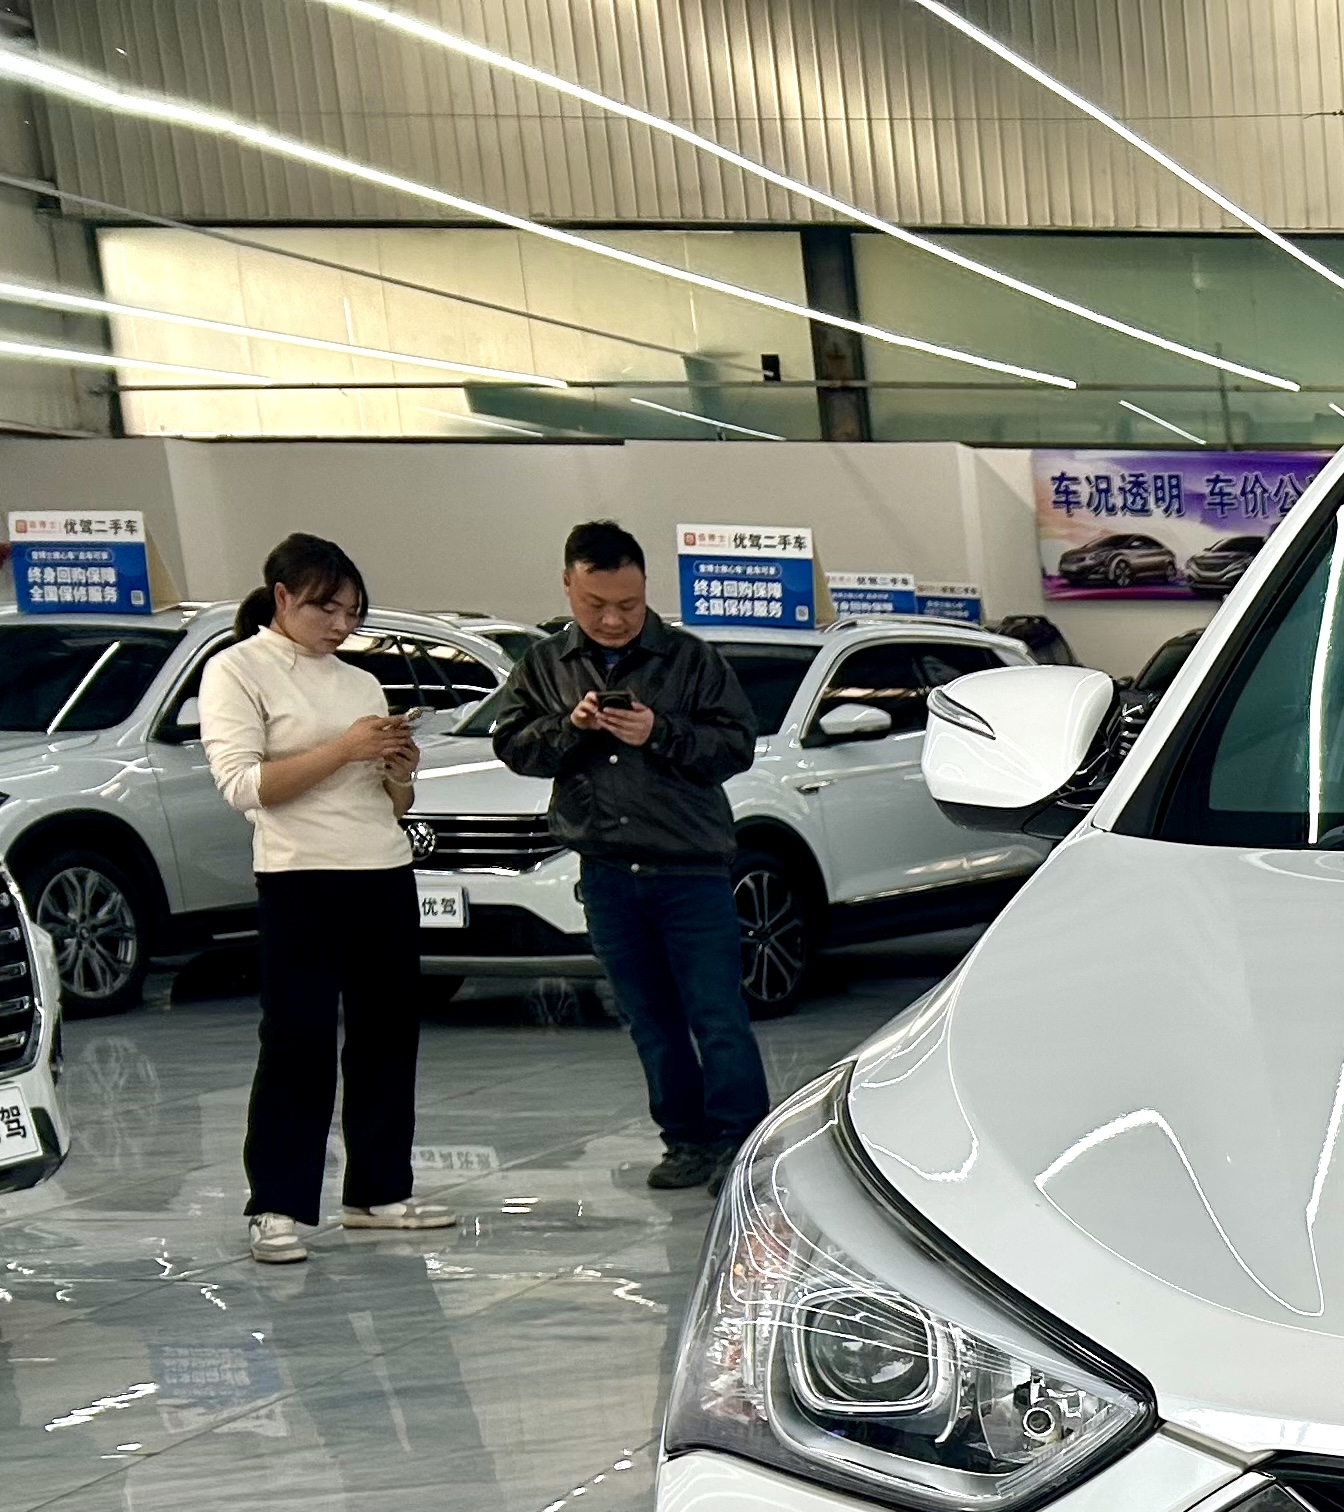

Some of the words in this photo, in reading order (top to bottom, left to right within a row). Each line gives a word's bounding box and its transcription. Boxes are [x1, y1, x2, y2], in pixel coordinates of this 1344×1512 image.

[1051, 472, 1184, 517] 车况透明
[1205, 472, 1317, 517] 车价公
[64, 519, 138, 535] 优驾二手车
[733, 532, 807, 551] 优驾二手车
[693, 579, 782, 599] 终身回购保障
[694, 597, 783, 618] 全国保修服务
[422, 897, 457, 916] 优驾
